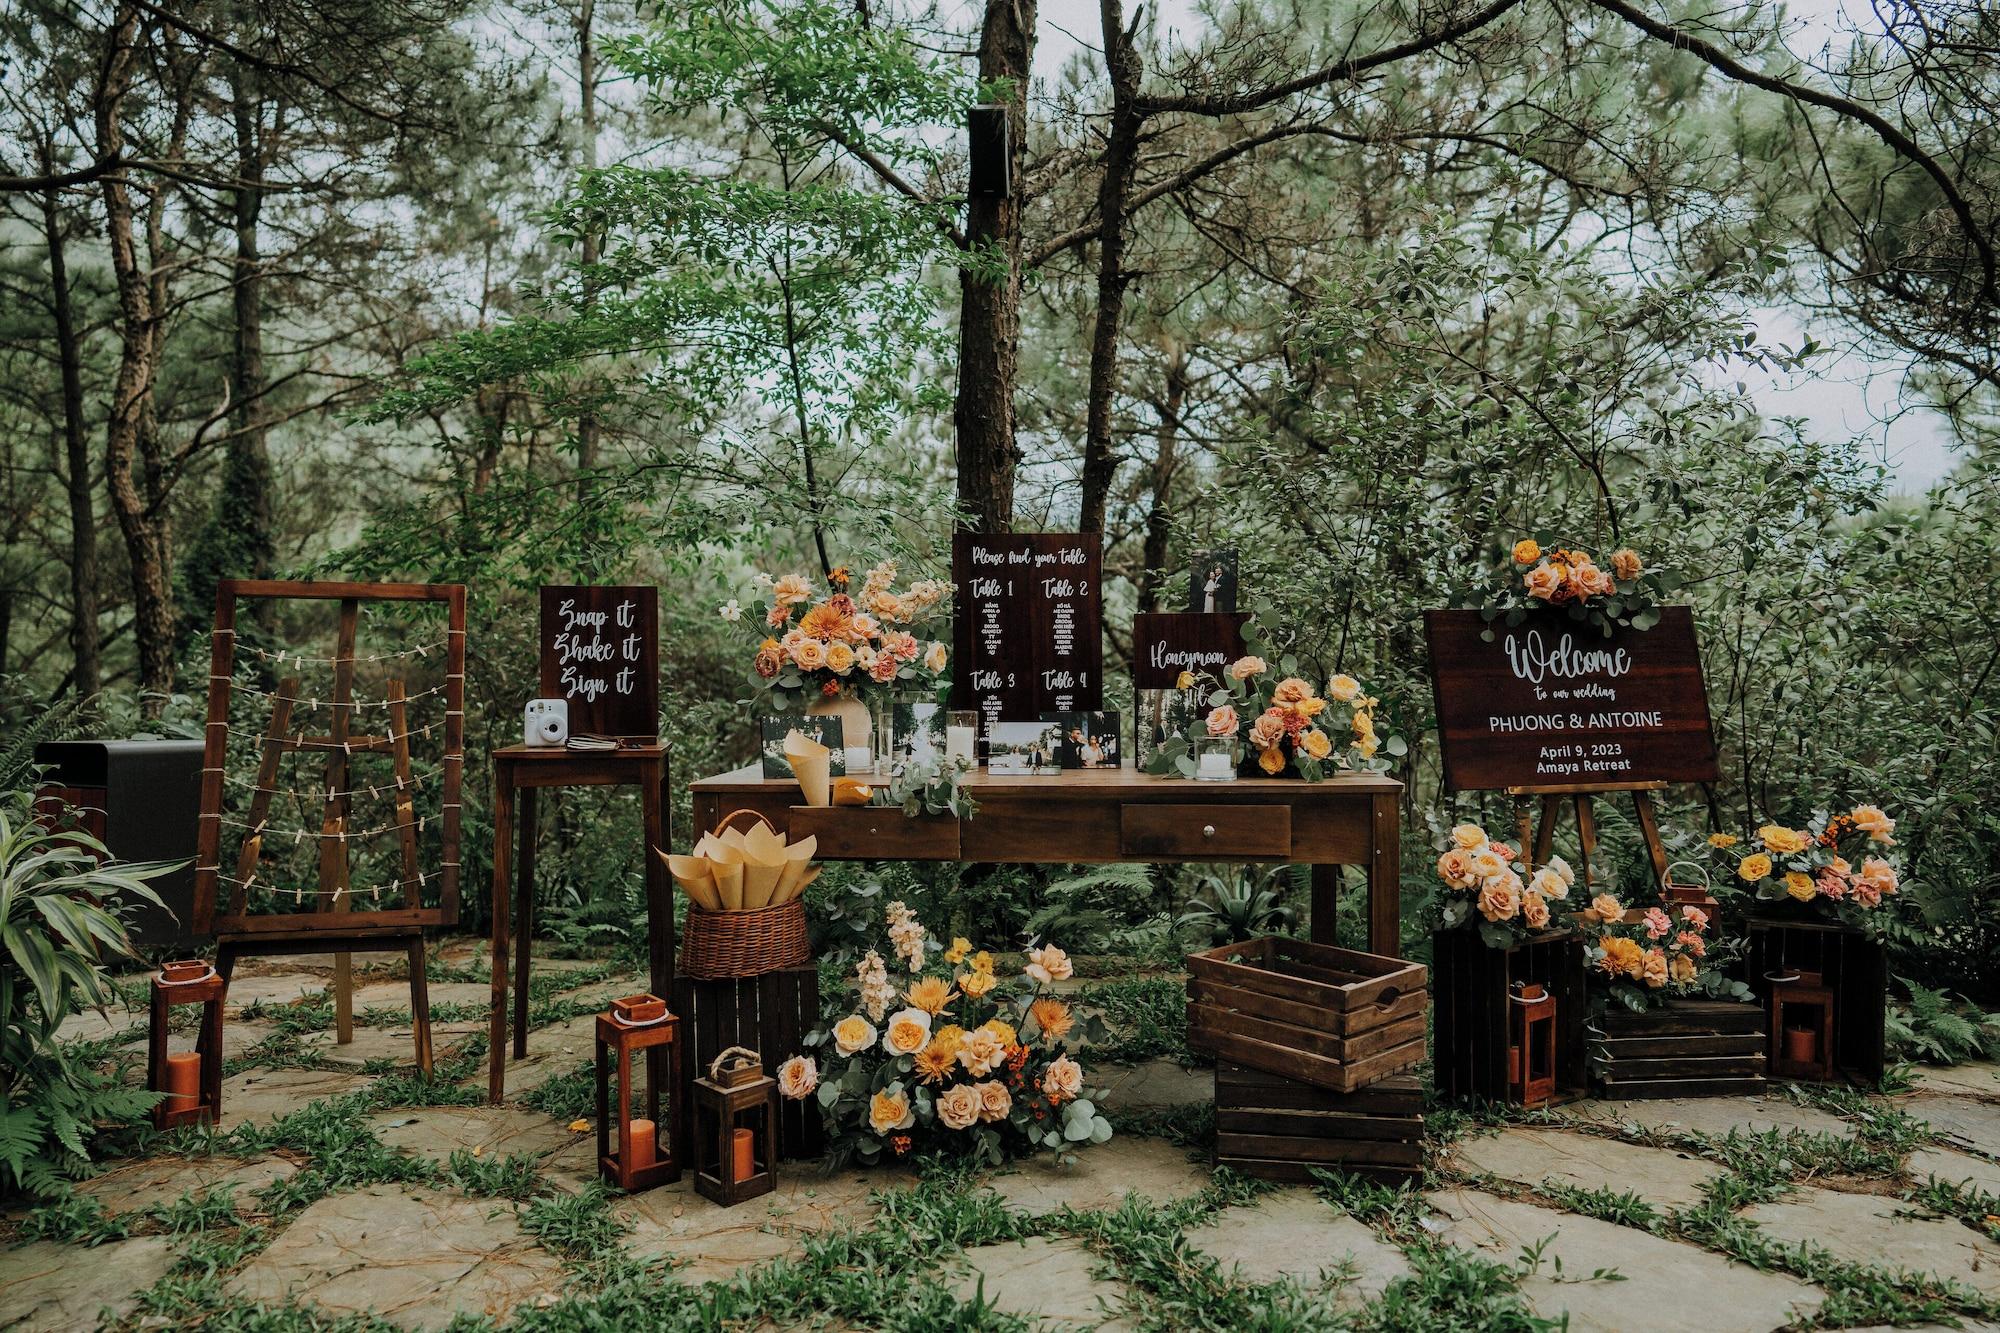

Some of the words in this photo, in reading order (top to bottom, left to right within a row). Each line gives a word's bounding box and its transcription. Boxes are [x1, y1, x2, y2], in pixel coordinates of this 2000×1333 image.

[972, 546, 1005, 565] Please
[1008, 547, 1031, 565] find
[1034, 553, 1057, 568] your
[1058, 547, 1087, 565] table
[969, 577, 1002, 599] Table
[1008, 580, 1013, 597] 1
[1041, 577, 1074, 599] Table
[1079, 580, 1088, 597] 2
[558, 598, 608, 634] Snap
[616, 599, 636, 628] it
[553, 632, 615, 665] Shake
[622, 633, 642, 662] it
[1150, 640, 1228, 672] Honeymoon
[1504, 629, 1632, 684] Welcome
[560, 666, 608, 703] Sign
[615, 666, 636, 695] it
[969, 670, 1002, 691] Table
[1008, 672, 1016, 688] 3
[1041, 670, 1074, 691] Table
[1080, 672, 1087, 688] 4
[1533, 685, 1548, 701] to
[1553, 689, 1569, 699] our
[1572, 683, 1616, 702] wedding
[1489, 713, 1565, 733] PHUONG
[1569, 713, 1584, 729] &
[1588, 711, 1663, 729] ANTOINE
[1540, 745, 1571, 761] April
[1575, 745, 1587, 758] 9,
[1591, 743, 1622, 756] 2023
[1536, 761, 1579, 775] Amaya
[1584, 759, 1631, 772] Retreat
